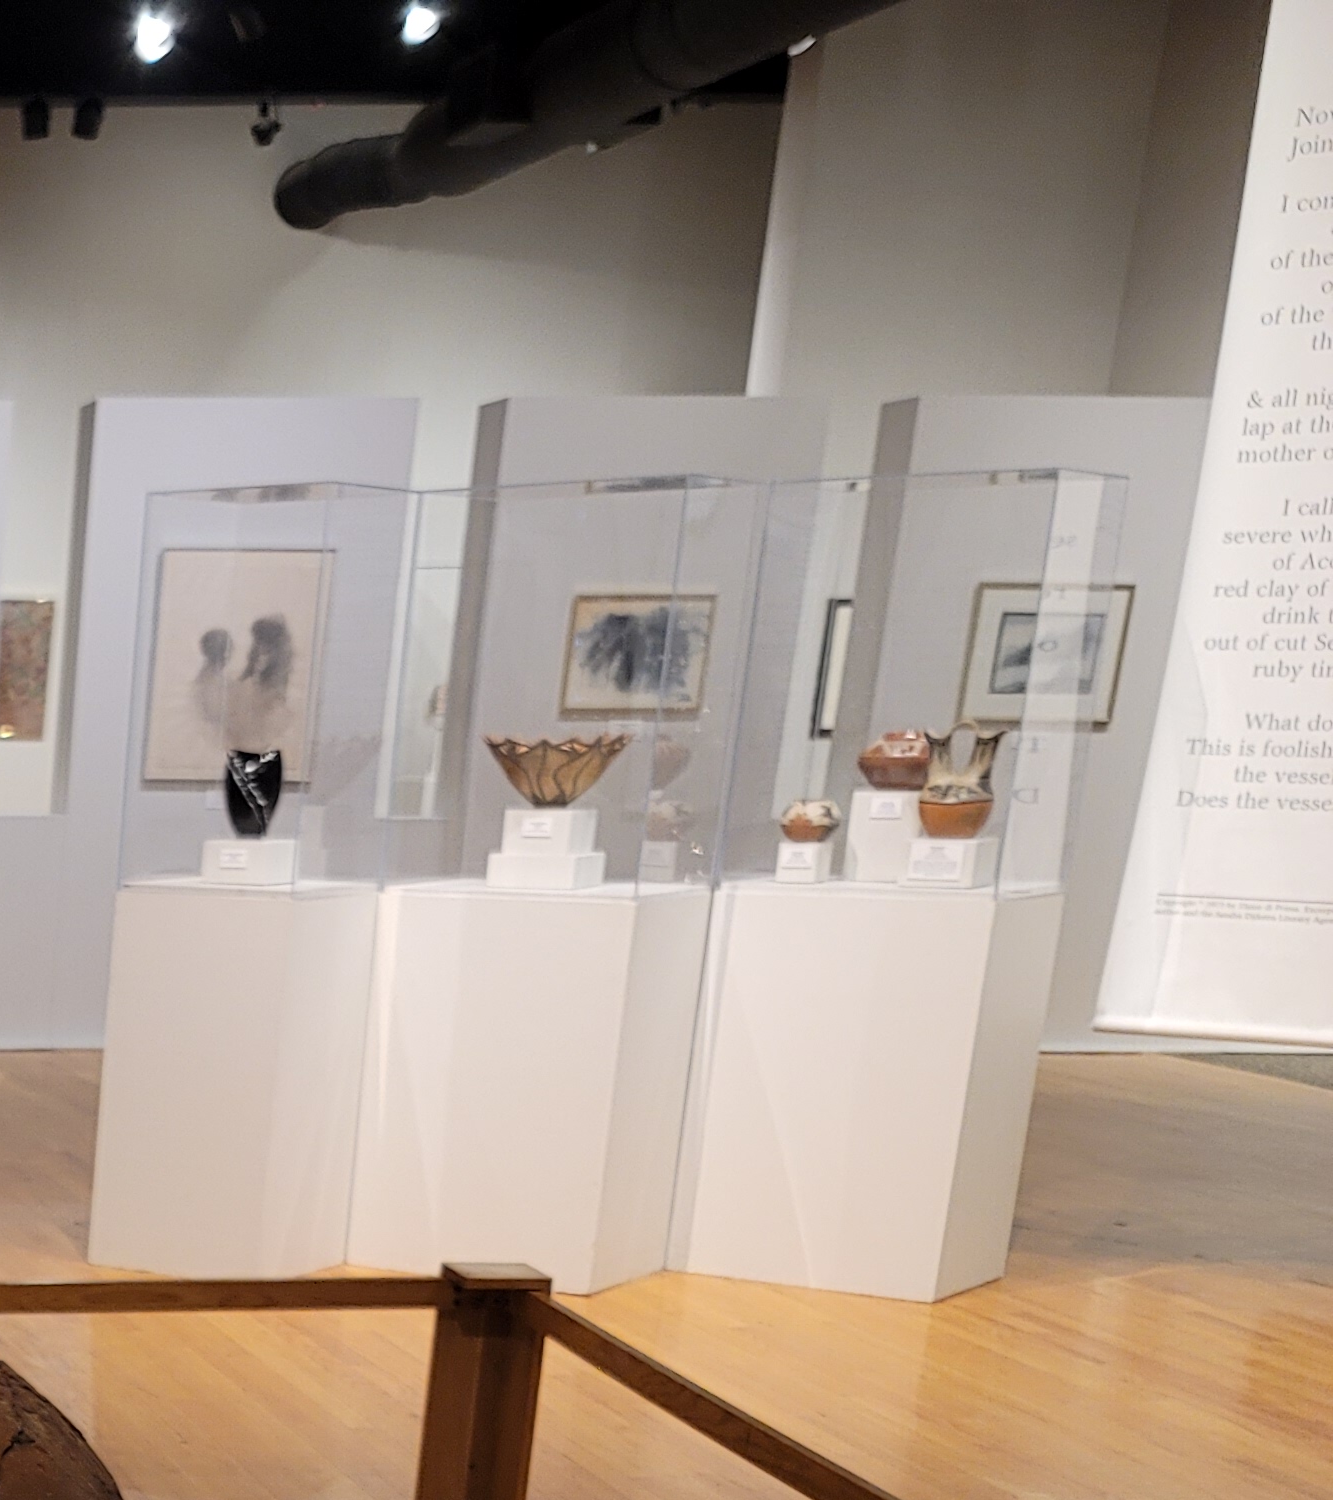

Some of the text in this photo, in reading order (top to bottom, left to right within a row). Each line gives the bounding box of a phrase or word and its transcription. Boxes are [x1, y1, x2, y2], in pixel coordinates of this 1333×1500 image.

[1281, 194, 1289, 213] I
[1270, 248, 1333, 270] of the
[1260, 304, 1325, 326] of the
[1247, 388, 1298, 409] & all
[1242, 417, 1302, 441] lap at
[1237, 443, 1317, 463] mother
[1282, 498, 1290, 517] I
[1223, 530, 1292, 544] severe
[1272, 552, 1296, 571] of
[1213, 578, 1330, 603] red clay of
[1262, 605, 1320, 625] drink
[1204, 631, 1307, 651] out of cut
[1252, 658, 1304, 683] ruby
[1245, 712, 1301, 732] What
[1186, 737, 1231, 757] This
[1238, 738, 1256, 757] is
[1234, 764, 1268, 784] the
[1175, 787, 1270, 810] Does the
